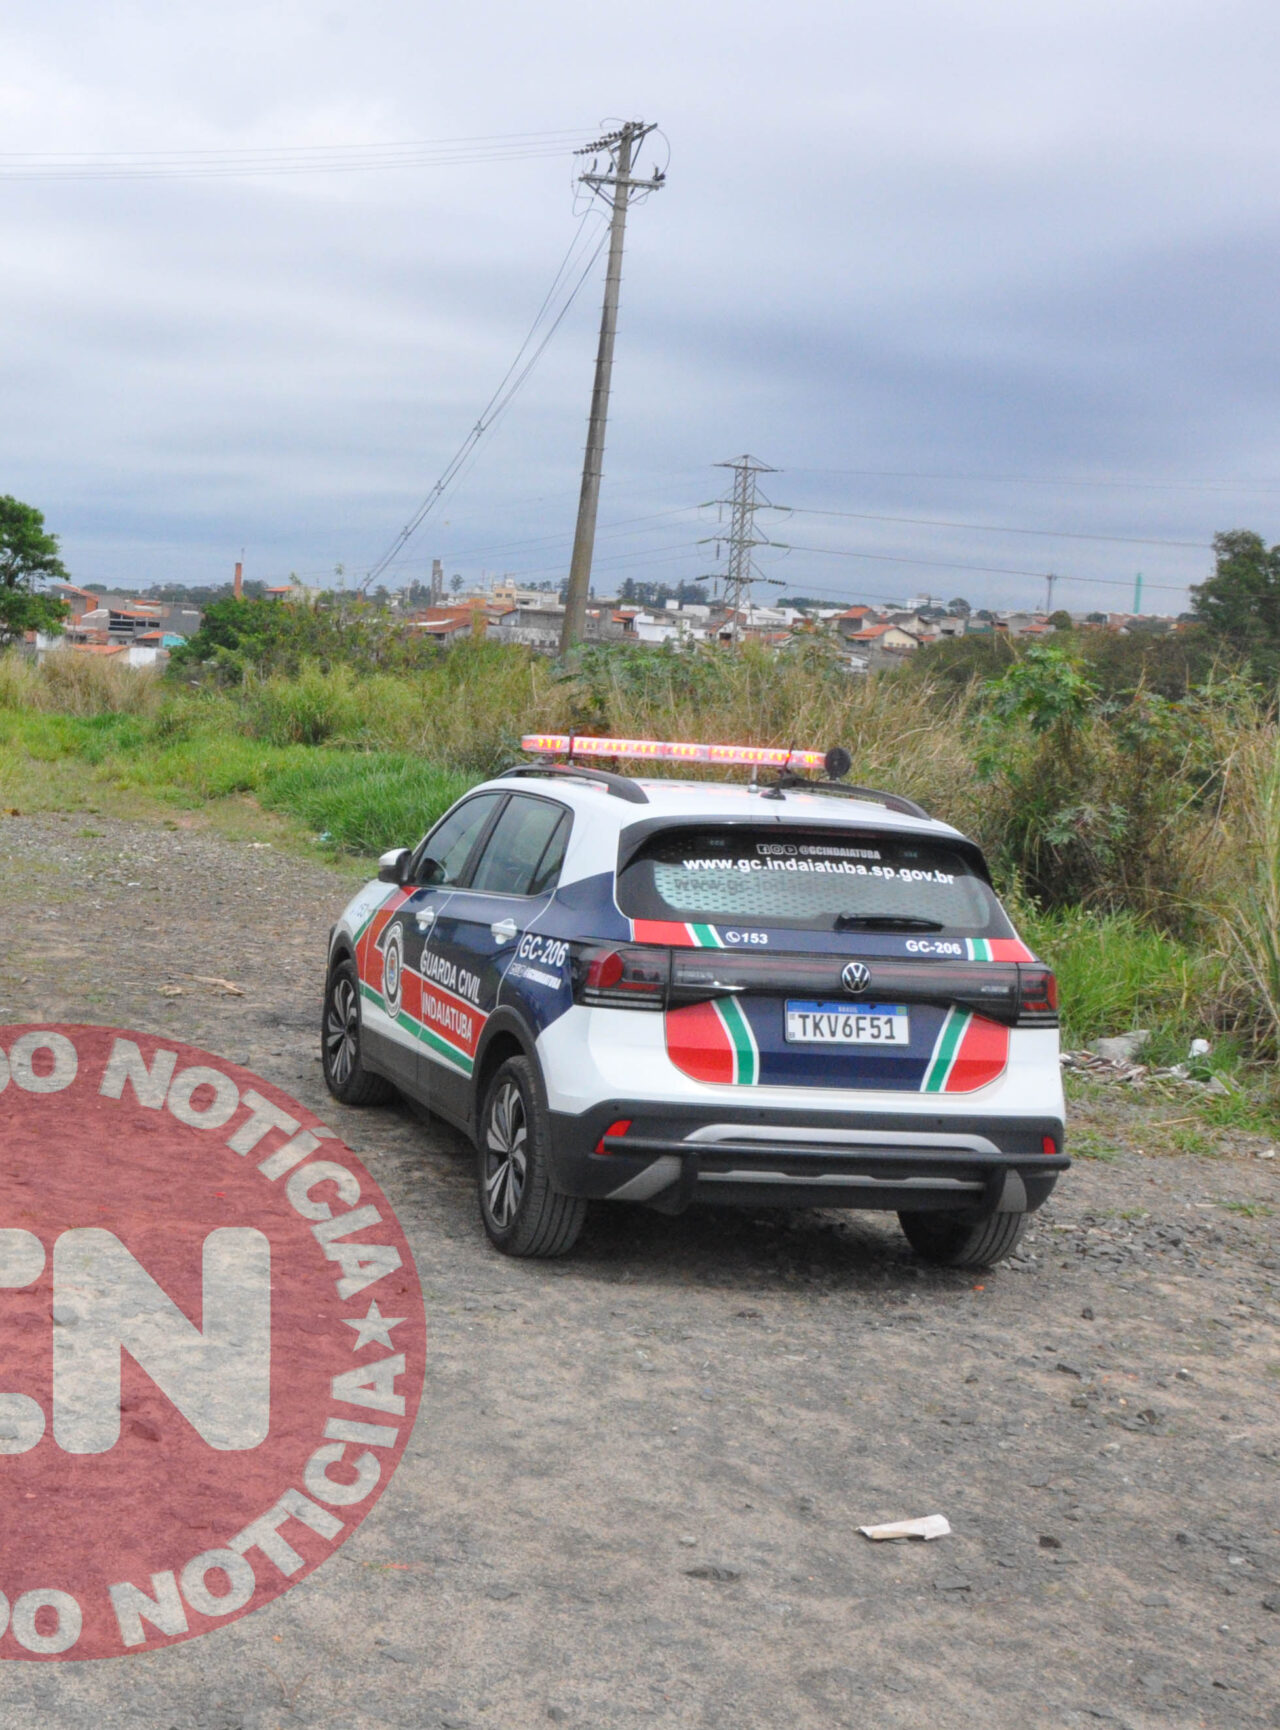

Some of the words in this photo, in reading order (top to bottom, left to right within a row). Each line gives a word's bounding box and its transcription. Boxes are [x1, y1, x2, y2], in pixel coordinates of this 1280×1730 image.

[683, 857, 955, 885] www.gc.indaiatuba.sp.gov.br
[519, 933, 570, 967] GC-206
[741, 932, 769, 945] 153
[905, 939, 962, 955] GC-206
[420, 949, 457, 990] GUARDA
[457, 968, 481, 1005] CIVIL
[422, 991, 473, 1044] INDAIATUBA
[798, 1014, 896, 1040] TKV6F51
